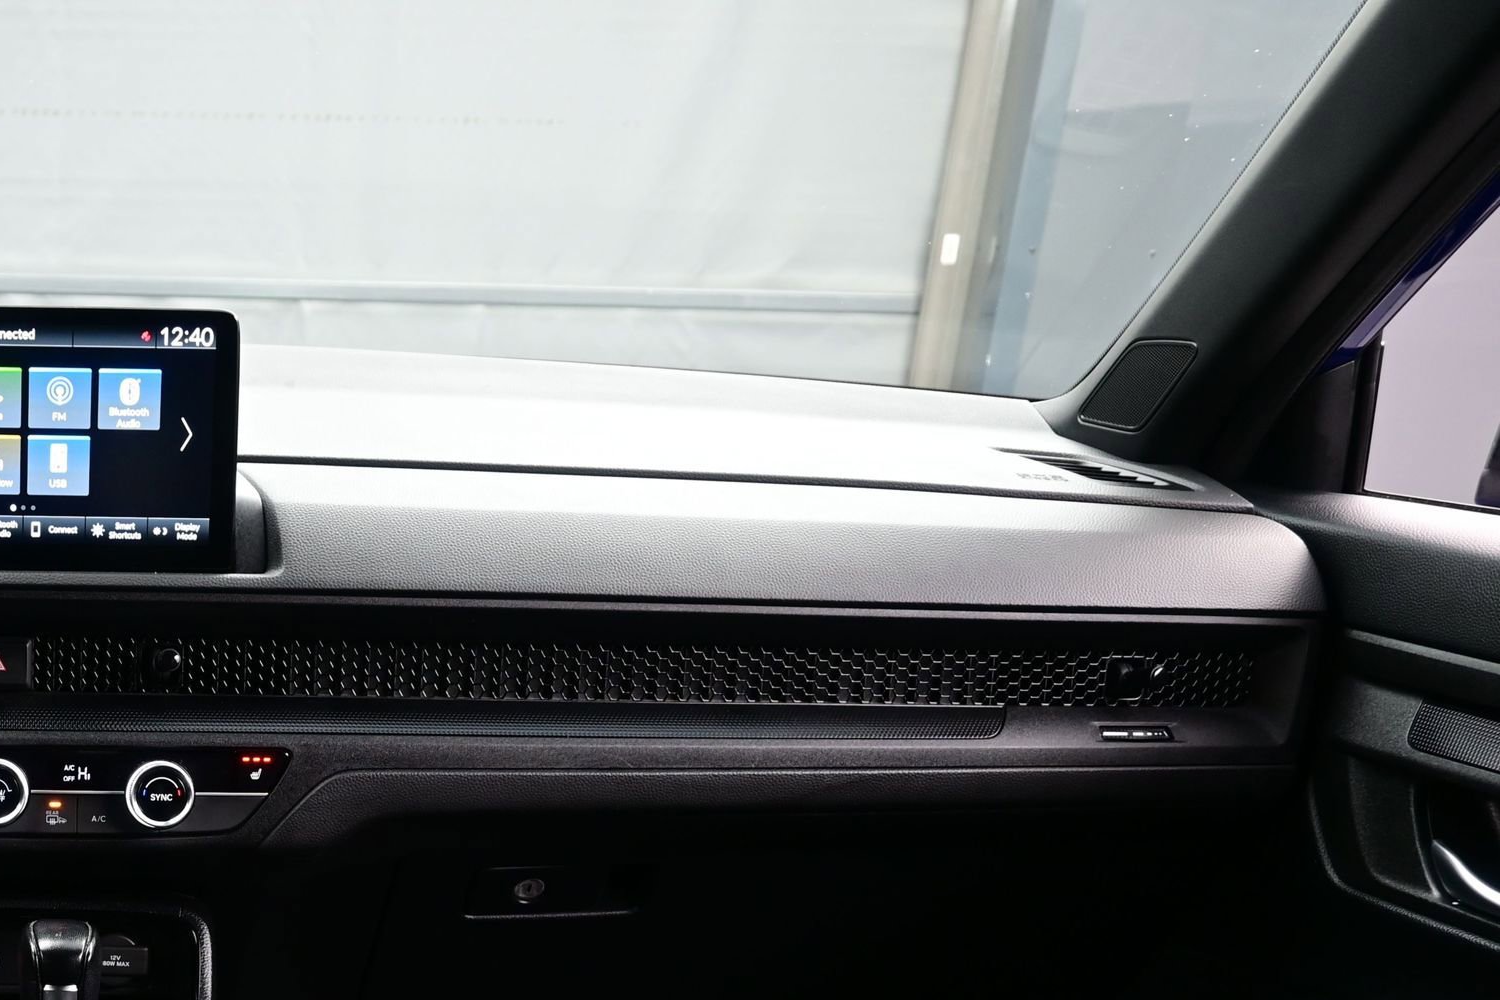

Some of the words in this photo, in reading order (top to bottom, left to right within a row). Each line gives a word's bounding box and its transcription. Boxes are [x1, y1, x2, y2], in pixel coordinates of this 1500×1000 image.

[160, 327, 215, 347] 12:40
[52, 412, 67, 421] FM
[109, 407, 150, 417] Bluetooth
[116, 419, 141, 429] Audio
[48, 479, 67, 488] USB
[48, 525, 78, 535] Connect
[115, 522, 136, 531] Smart
[175, 523, 200, 533] Display
[108, 531, 142, 540] Shortcuts
[176, 532, 197, 541] Mode
[150, 793, 173, 801] SYNC
